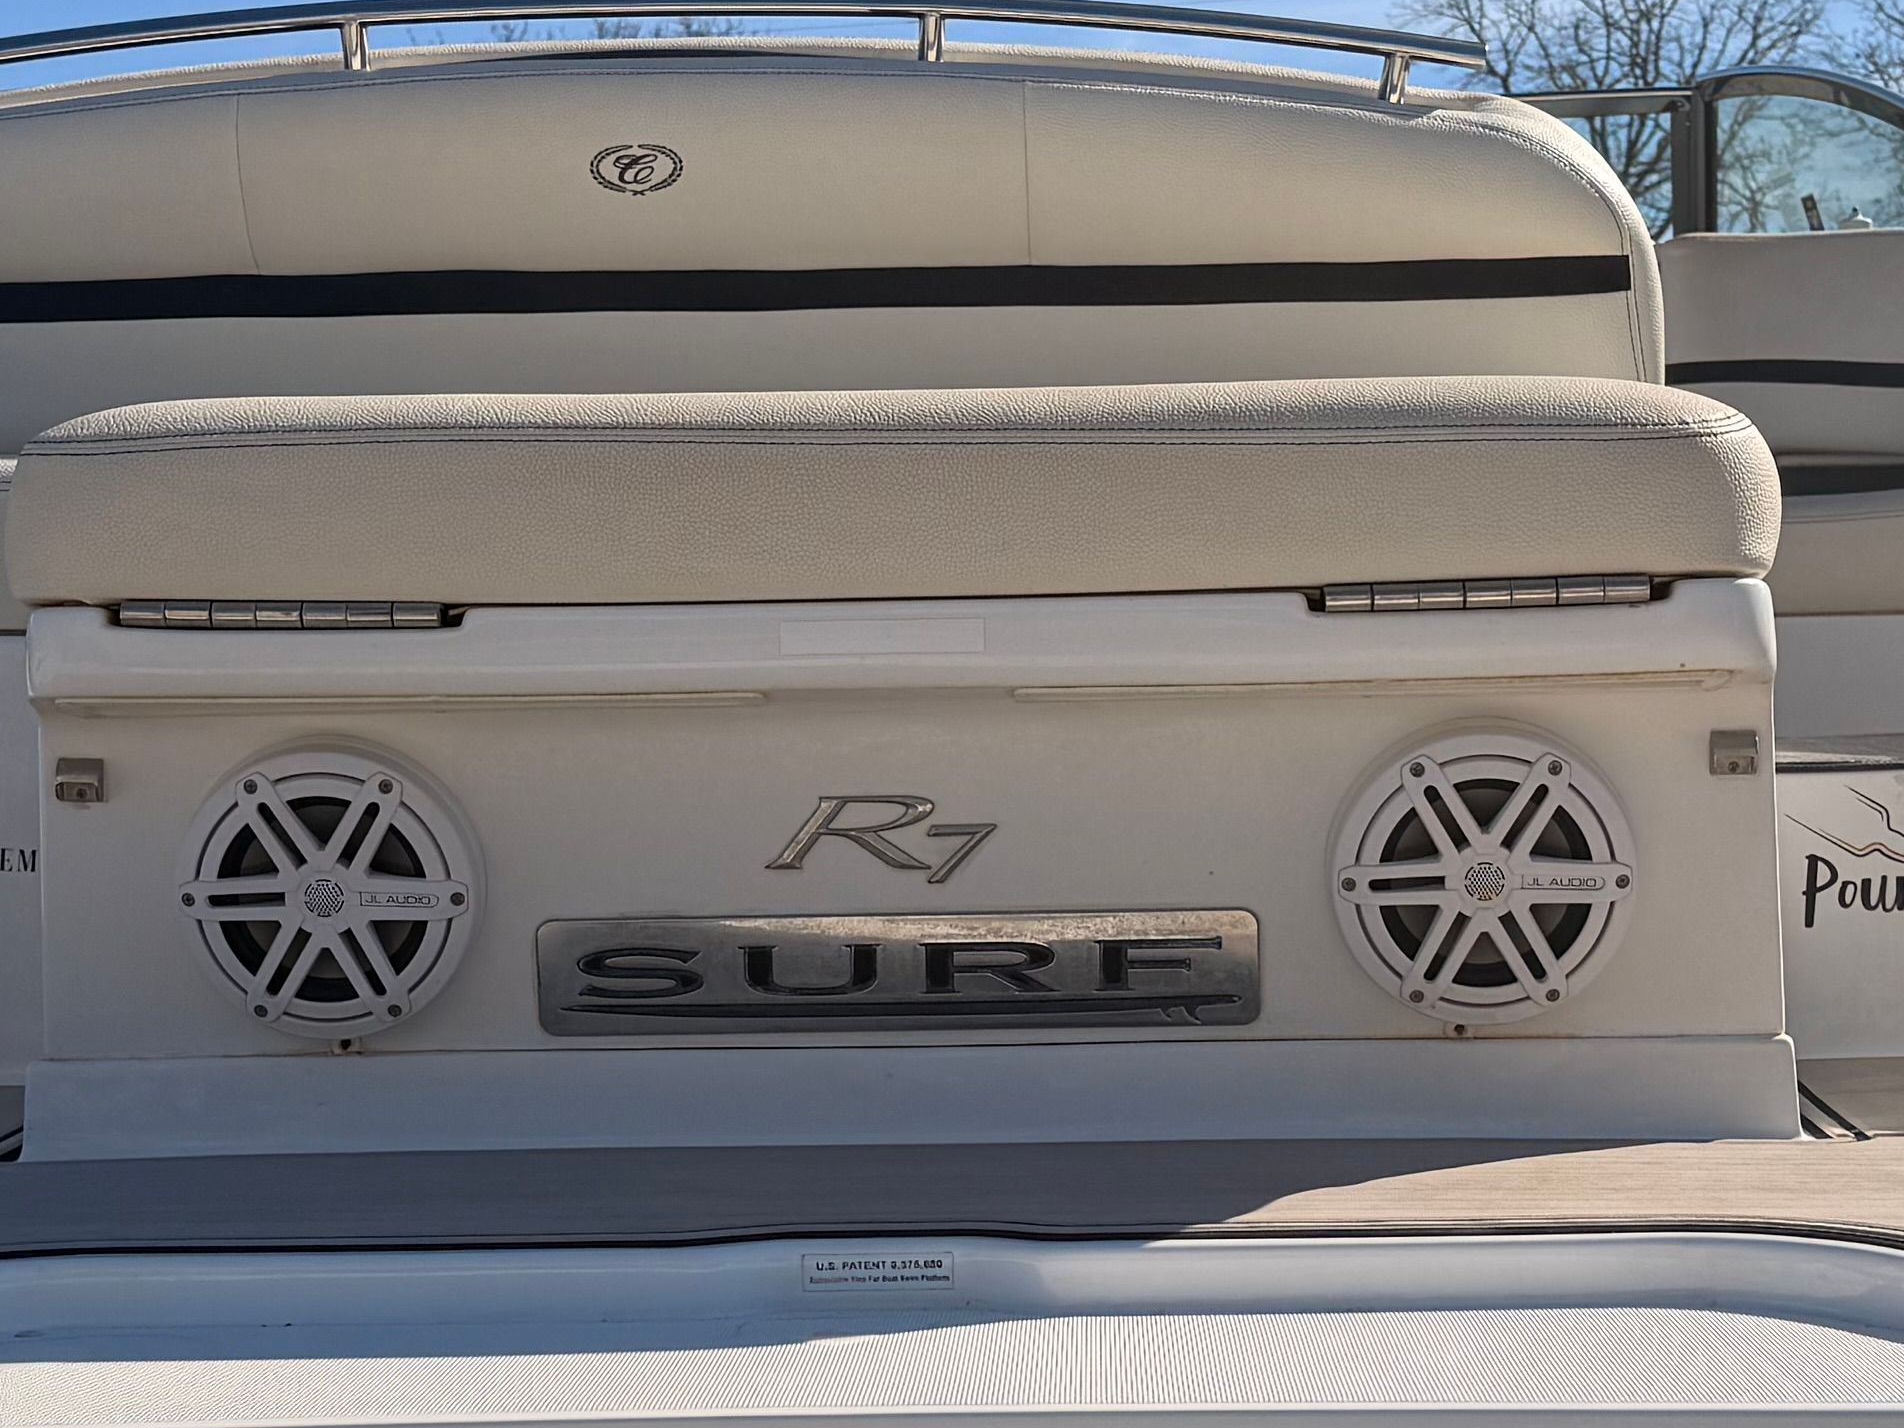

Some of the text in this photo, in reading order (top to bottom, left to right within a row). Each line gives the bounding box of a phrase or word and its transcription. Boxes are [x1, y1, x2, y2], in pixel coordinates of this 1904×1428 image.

[765, 793, 997, 884] R7
[1527, 877, 1597, 887] JL AUDIO
[365, 894, 431, 905] JL AUDIO
[577, 936, 1223, 999] SURF
[842, 1260, 886, 1270] PATENT
